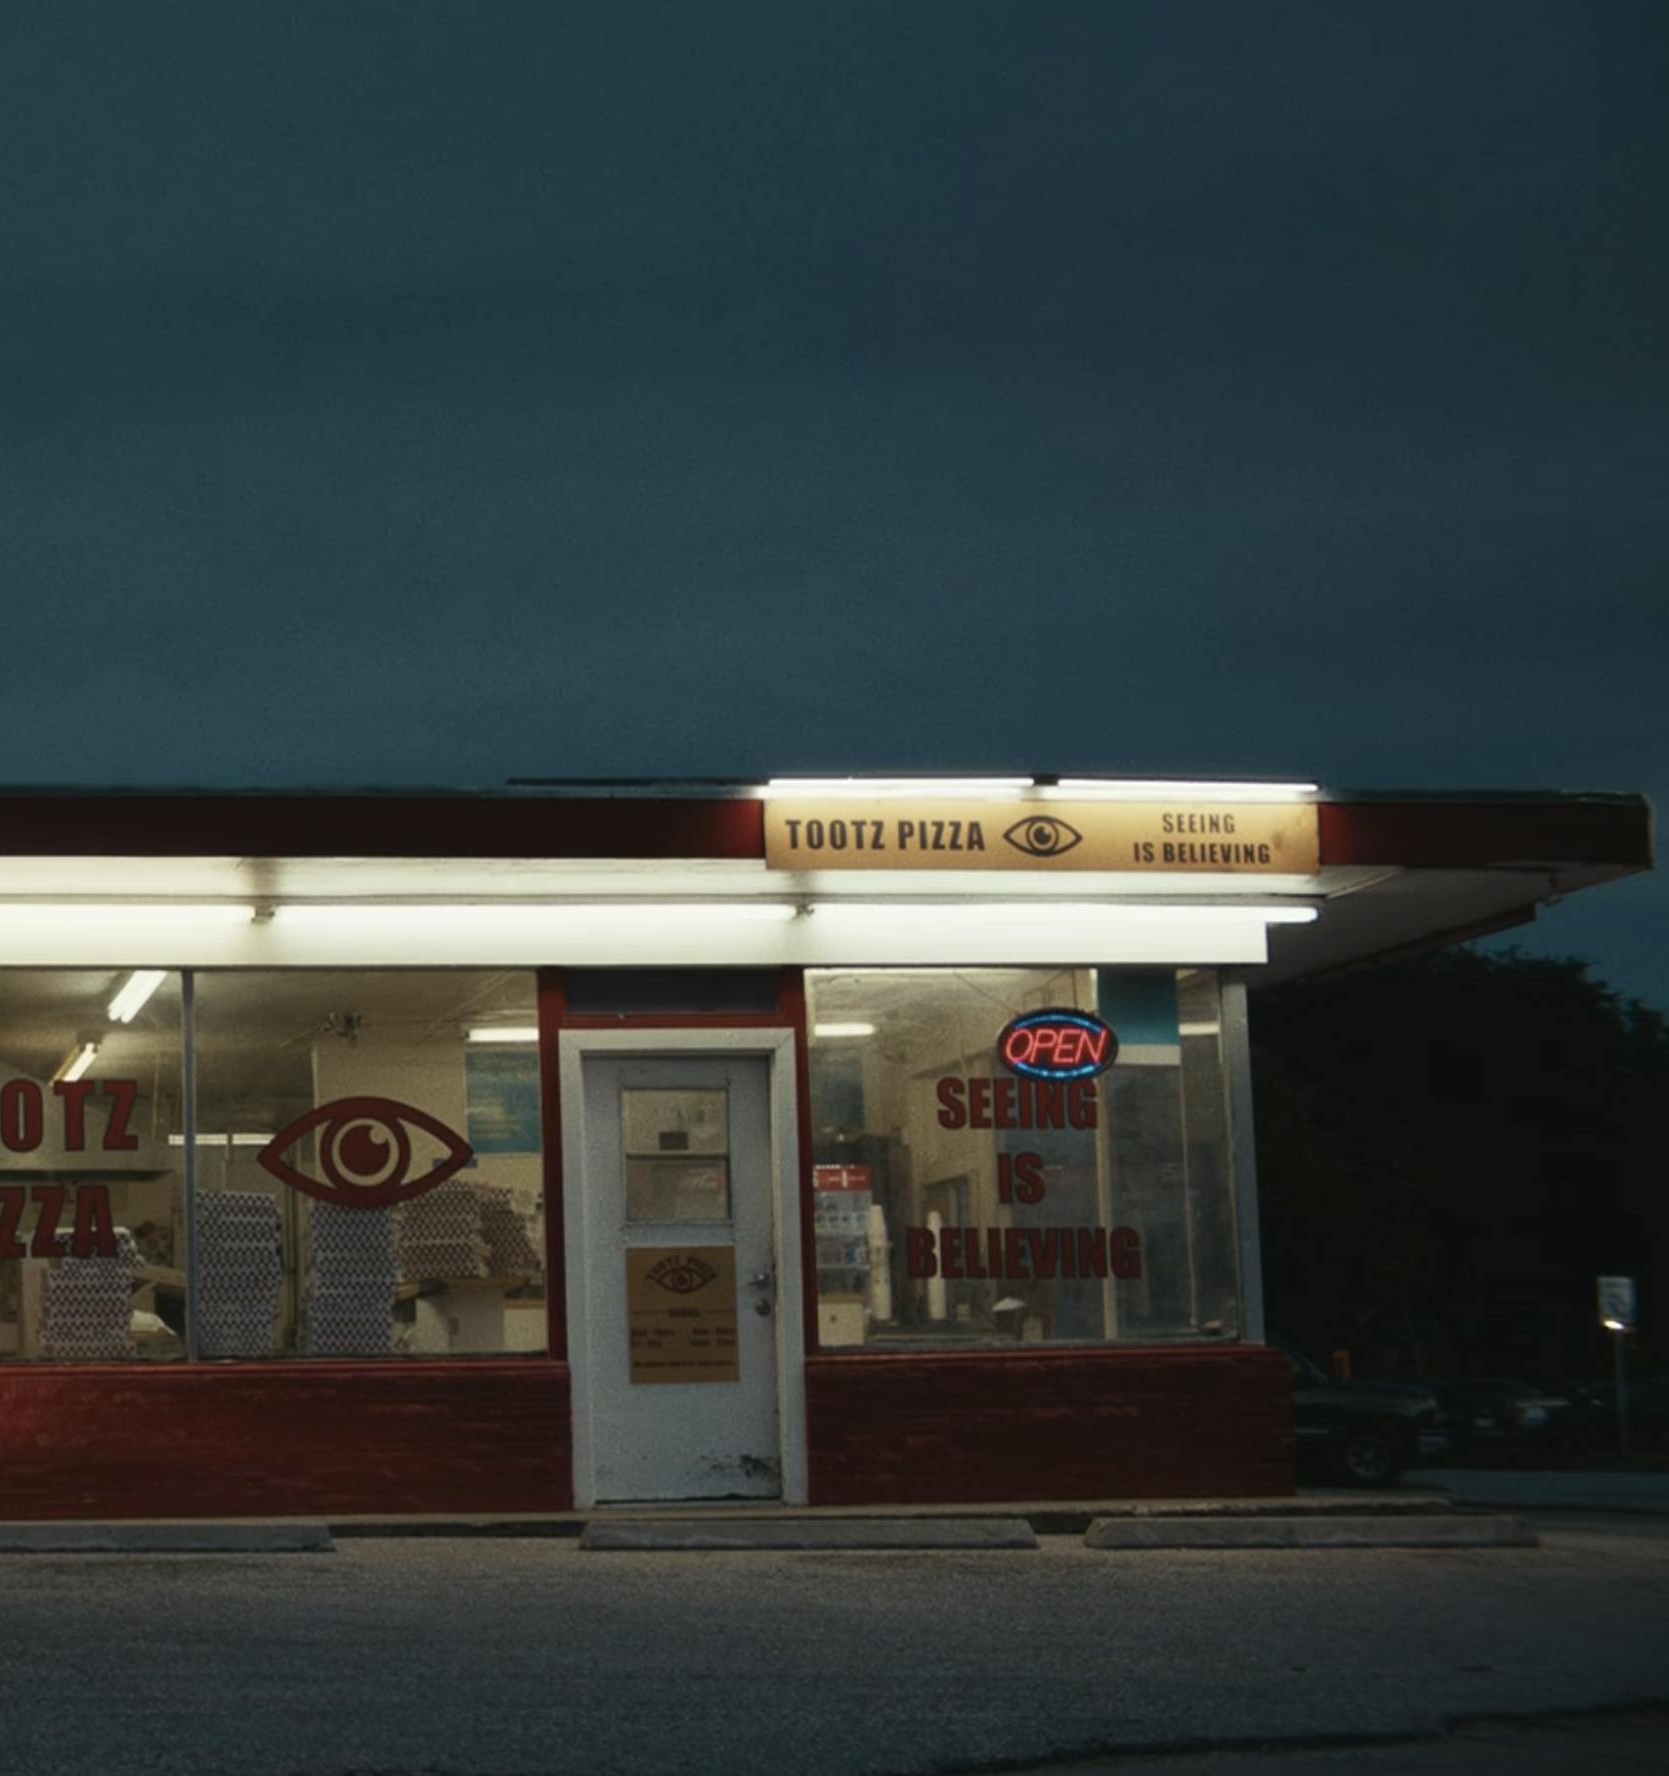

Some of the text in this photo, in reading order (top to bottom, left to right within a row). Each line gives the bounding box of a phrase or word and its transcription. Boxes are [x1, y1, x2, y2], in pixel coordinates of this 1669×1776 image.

[785, 820, 985, 851] TOOTZ PIZZA
[1162, 812, 1235, 834] SEEING
[1133, 842, 1270, 865] IS BELIEVING
[1004, 1028, 1107, 1065] OPEN
[936, 1077, 1097, 1129] SEEING
[997, 1152, 1045, 1204] IS
[906, 1226, 1142, 1280] BELIEVING
